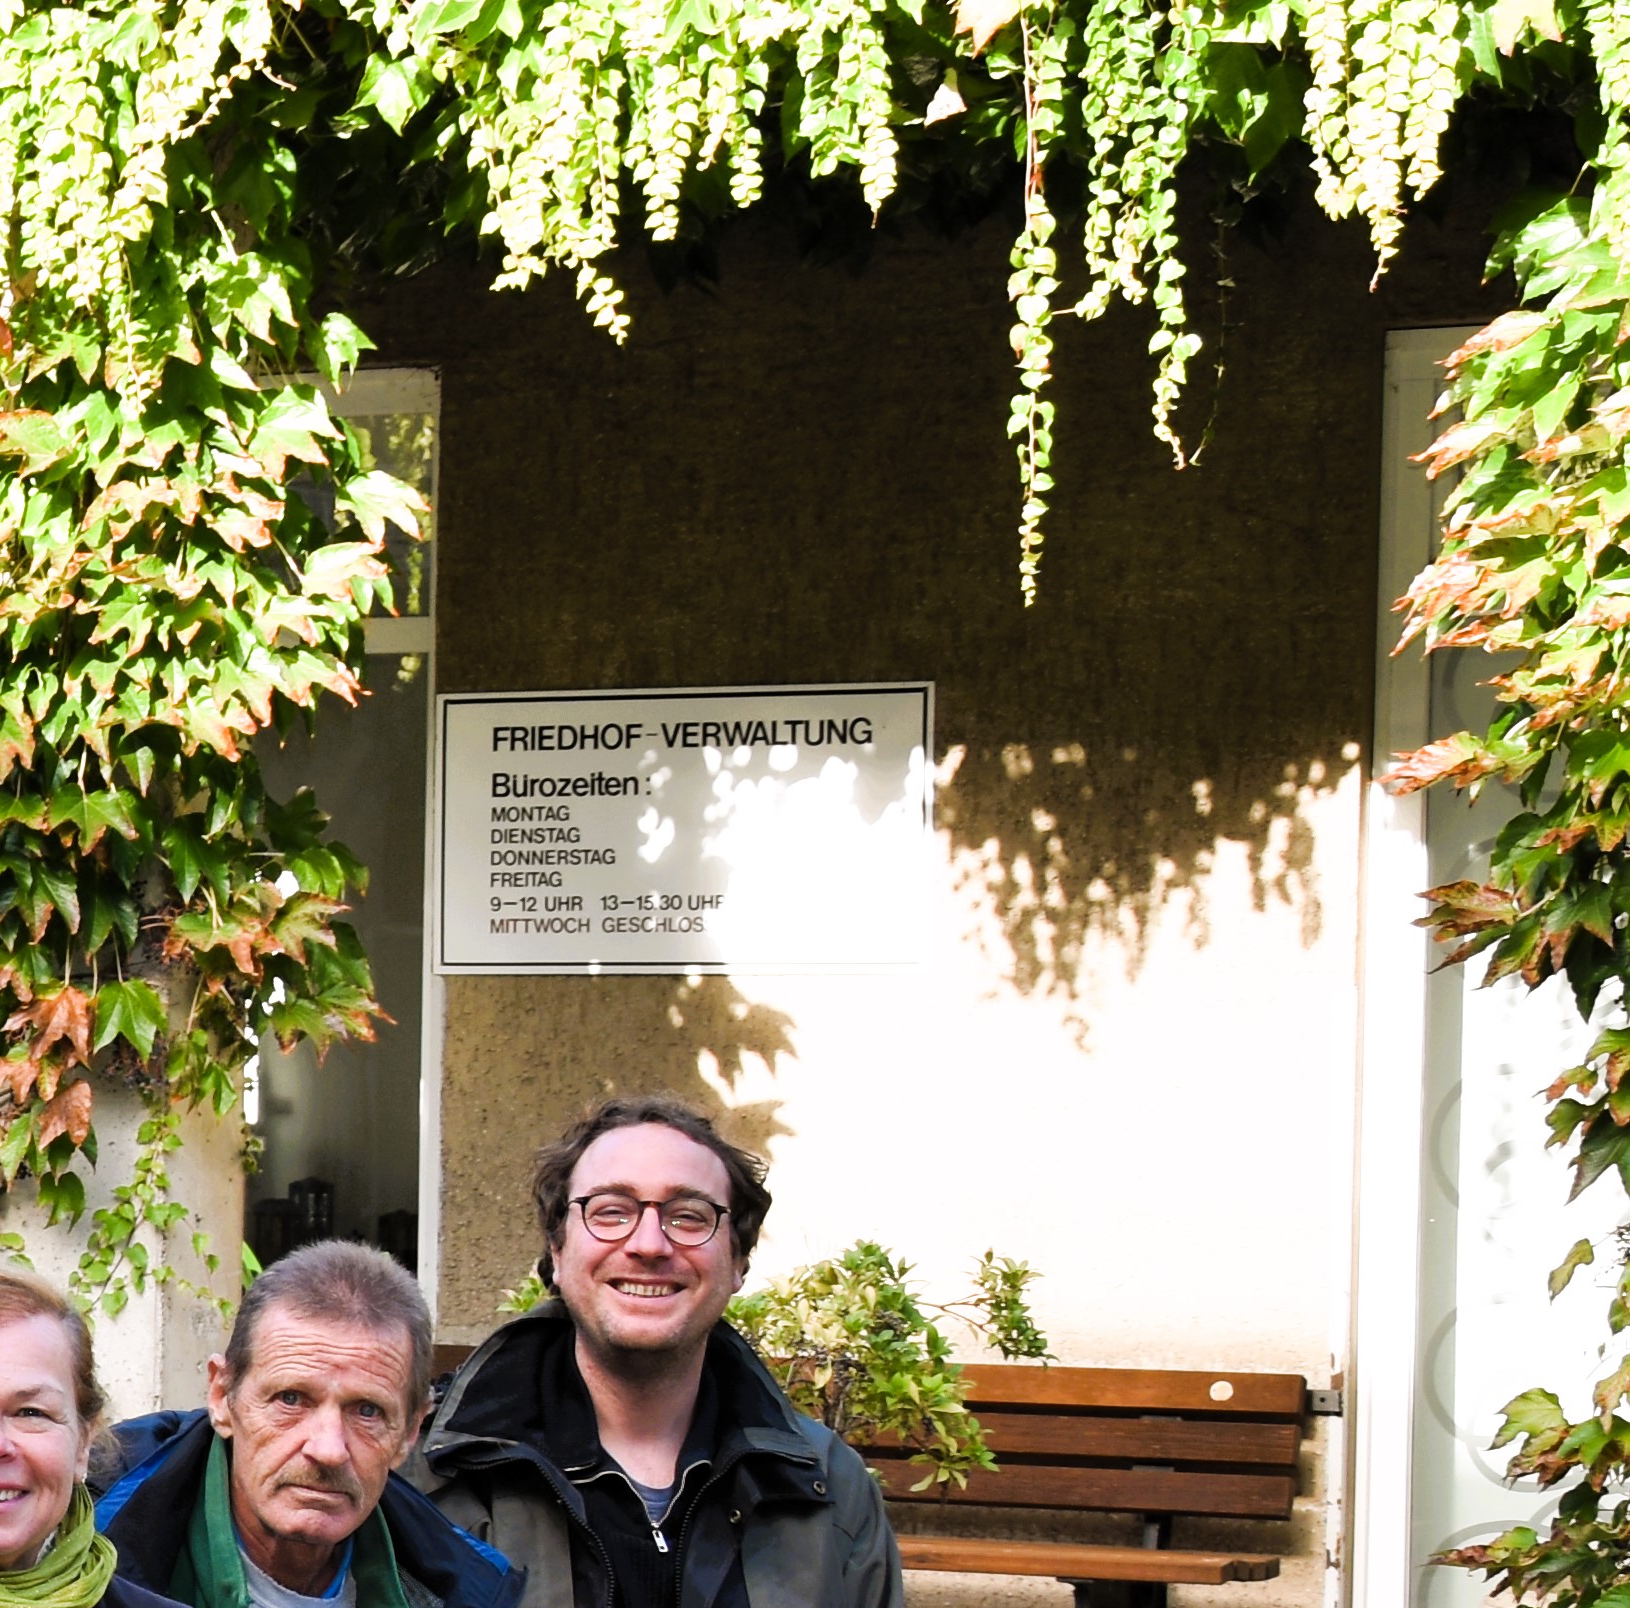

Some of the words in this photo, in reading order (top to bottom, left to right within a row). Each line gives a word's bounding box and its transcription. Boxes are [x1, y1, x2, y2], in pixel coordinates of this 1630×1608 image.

[492, 717, 874, 752] FRIEDHOF-VERWALTUNG
[490, 805, 570, 823] MONTAG
[490, 827, 581, 844] DIENSTAG
[490, 848, 616, 866] DONNERSTAG
[489, 871, 563, 888] FREITAG
[544, 895, 583, 912] UHR
[489, 917, 591, 934] MITTWOCH
[601, 916, 707, 933] GESCHLOS
